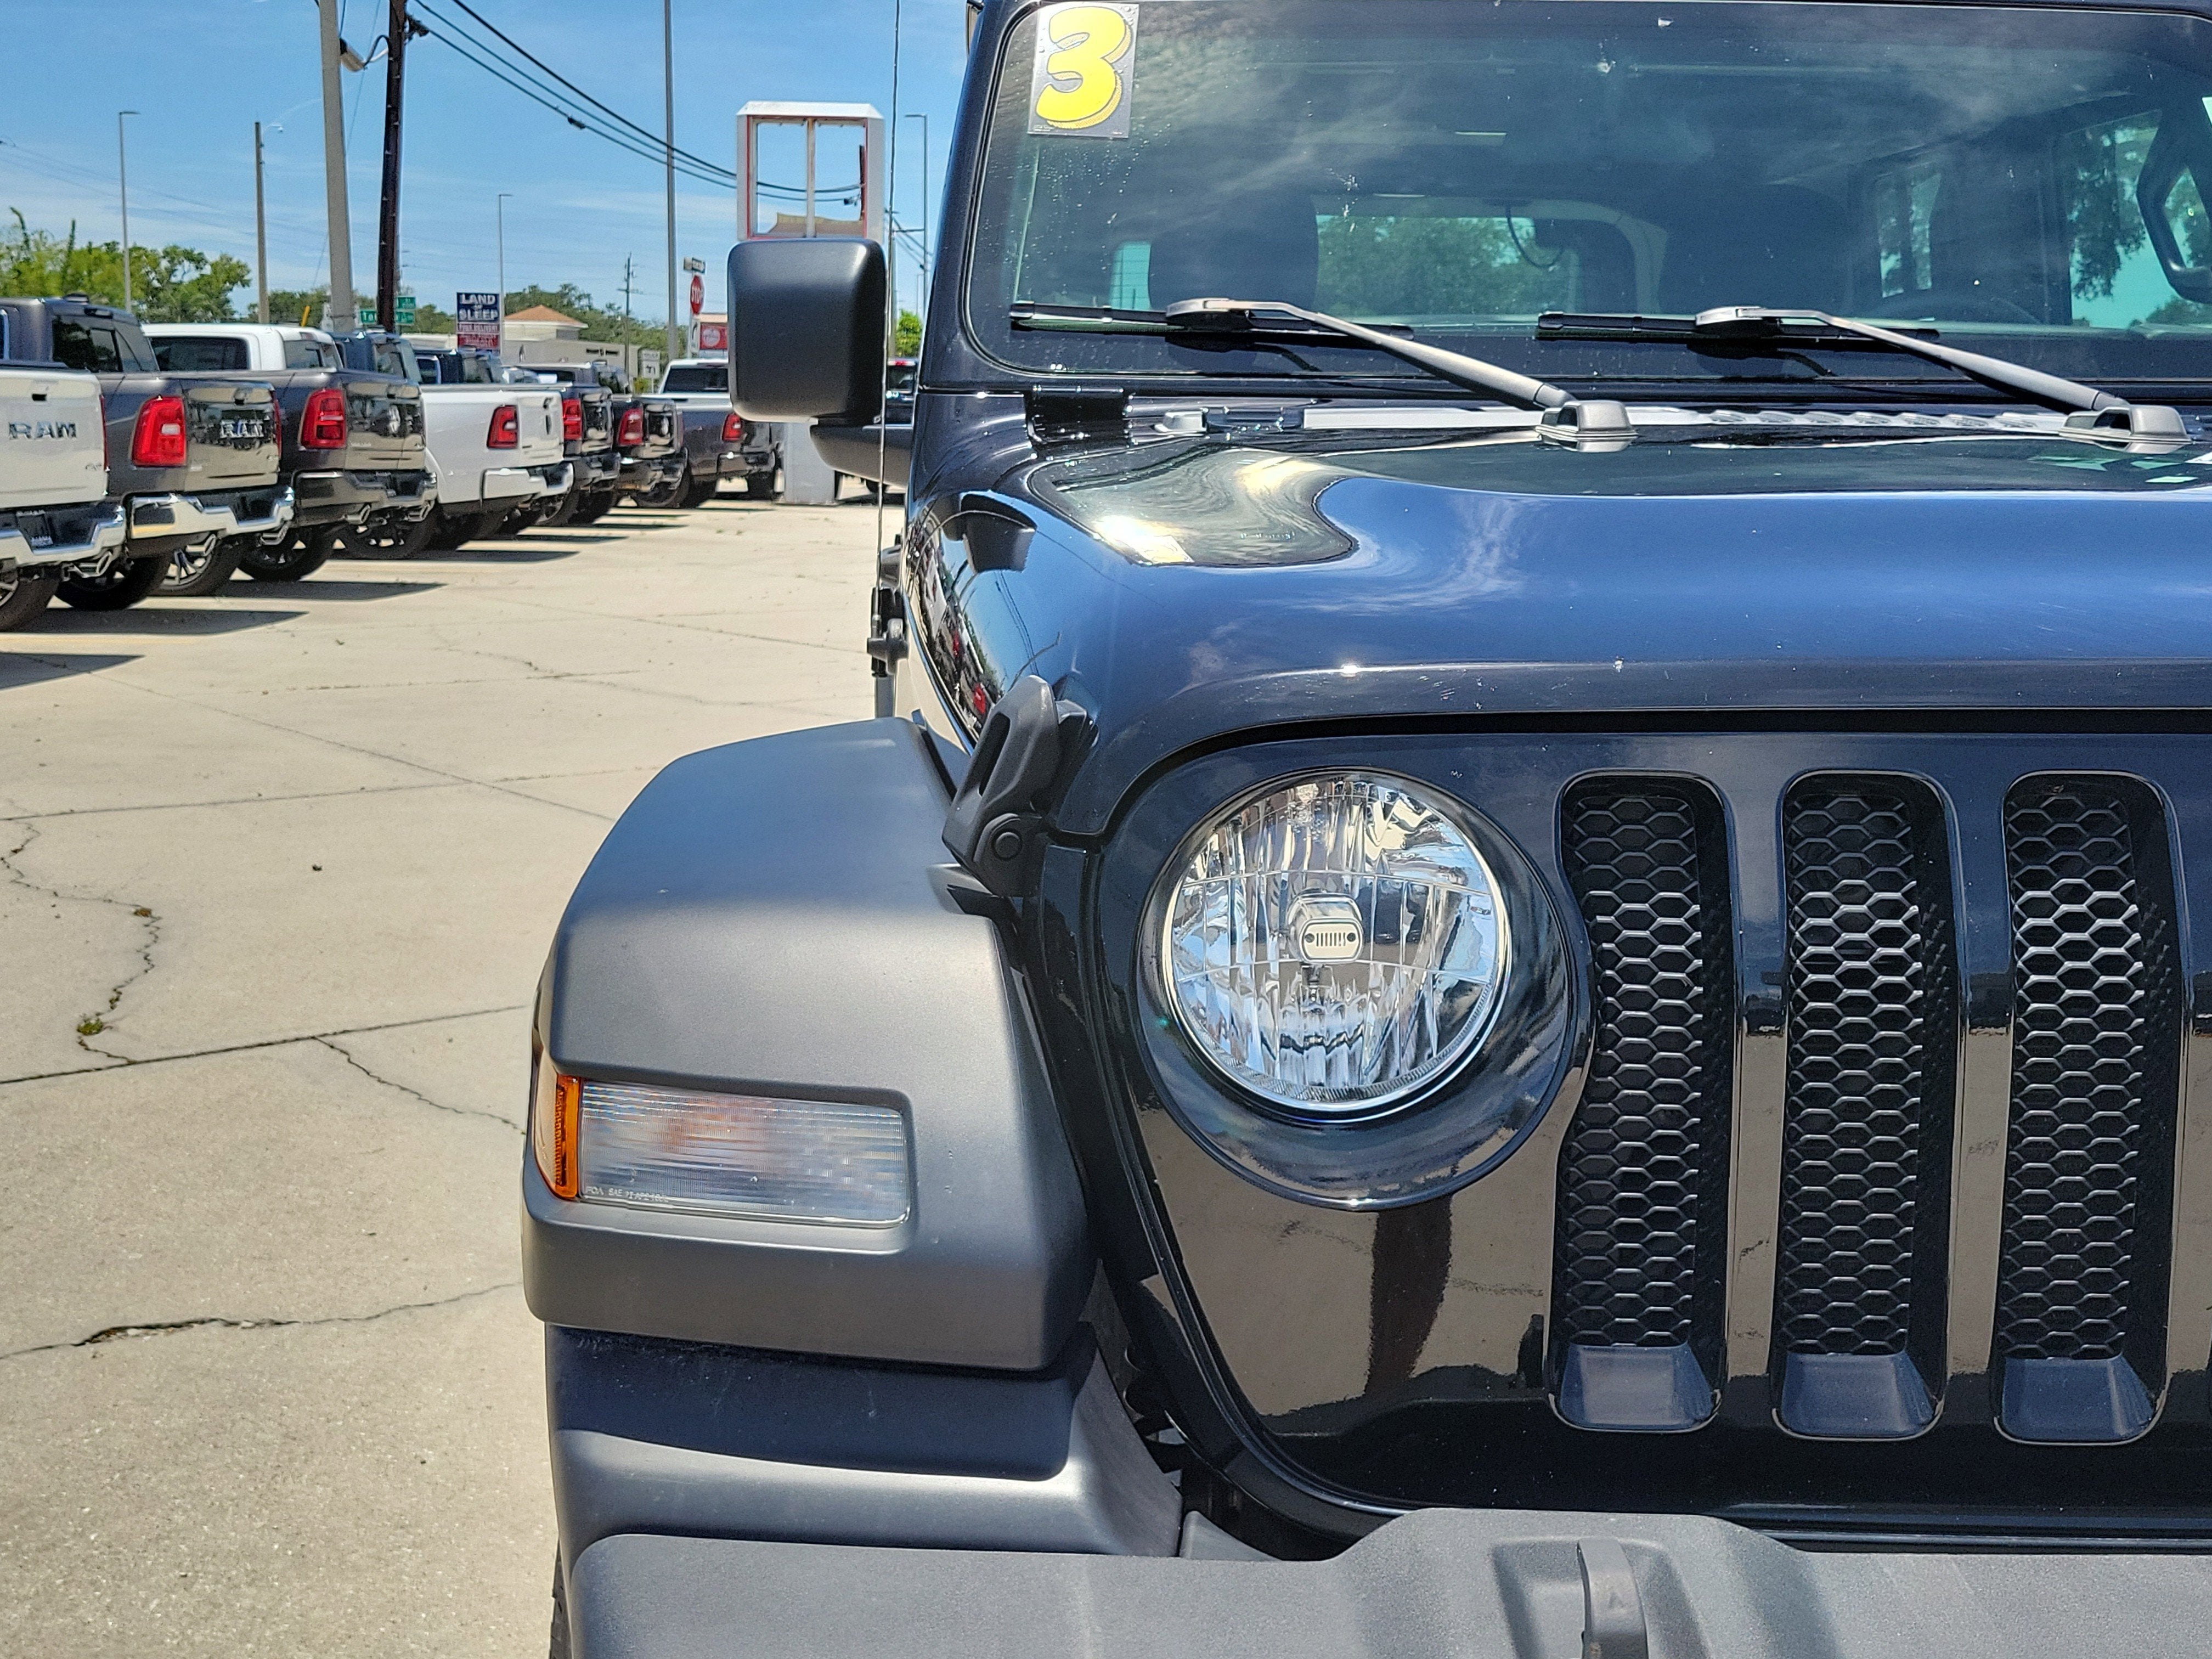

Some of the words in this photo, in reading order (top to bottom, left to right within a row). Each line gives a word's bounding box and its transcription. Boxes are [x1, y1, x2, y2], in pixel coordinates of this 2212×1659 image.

[1036, 6, 1131, 129] 3
[460, 294, 495, 304] LAND
[459, 308, 498, 320] SLEEP
[8, 421, 77, 439] RAM
[220, 419, 264, 438] RAM
